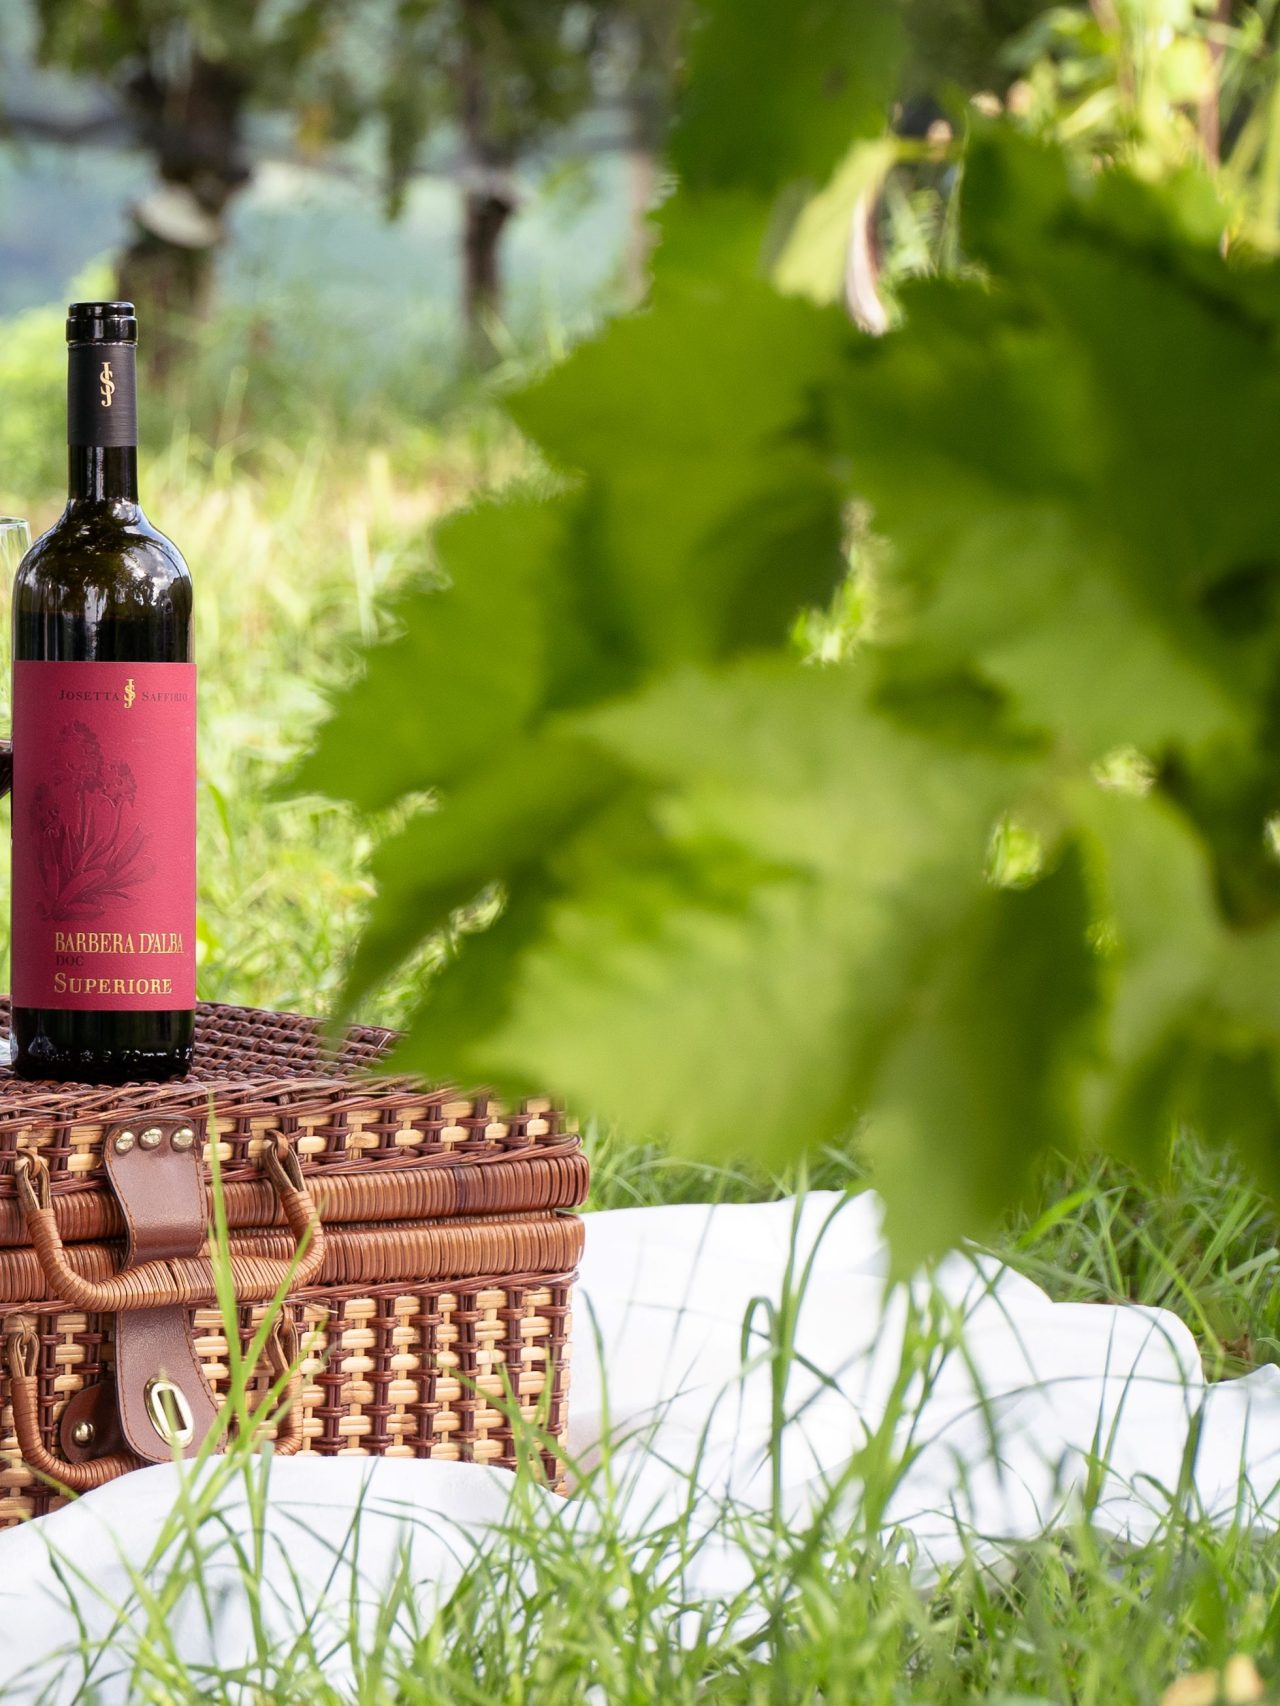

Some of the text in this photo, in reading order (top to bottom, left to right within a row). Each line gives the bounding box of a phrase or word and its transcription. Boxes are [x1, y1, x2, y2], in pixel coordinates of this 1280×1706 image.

[58, 689, 119, 701] JOSETTA
[55, 931, 184, 954] BARBERA D'ALBA
[56, 955, 84, 967] DOC
[54, 972, 172, 995] SUPERIORE
